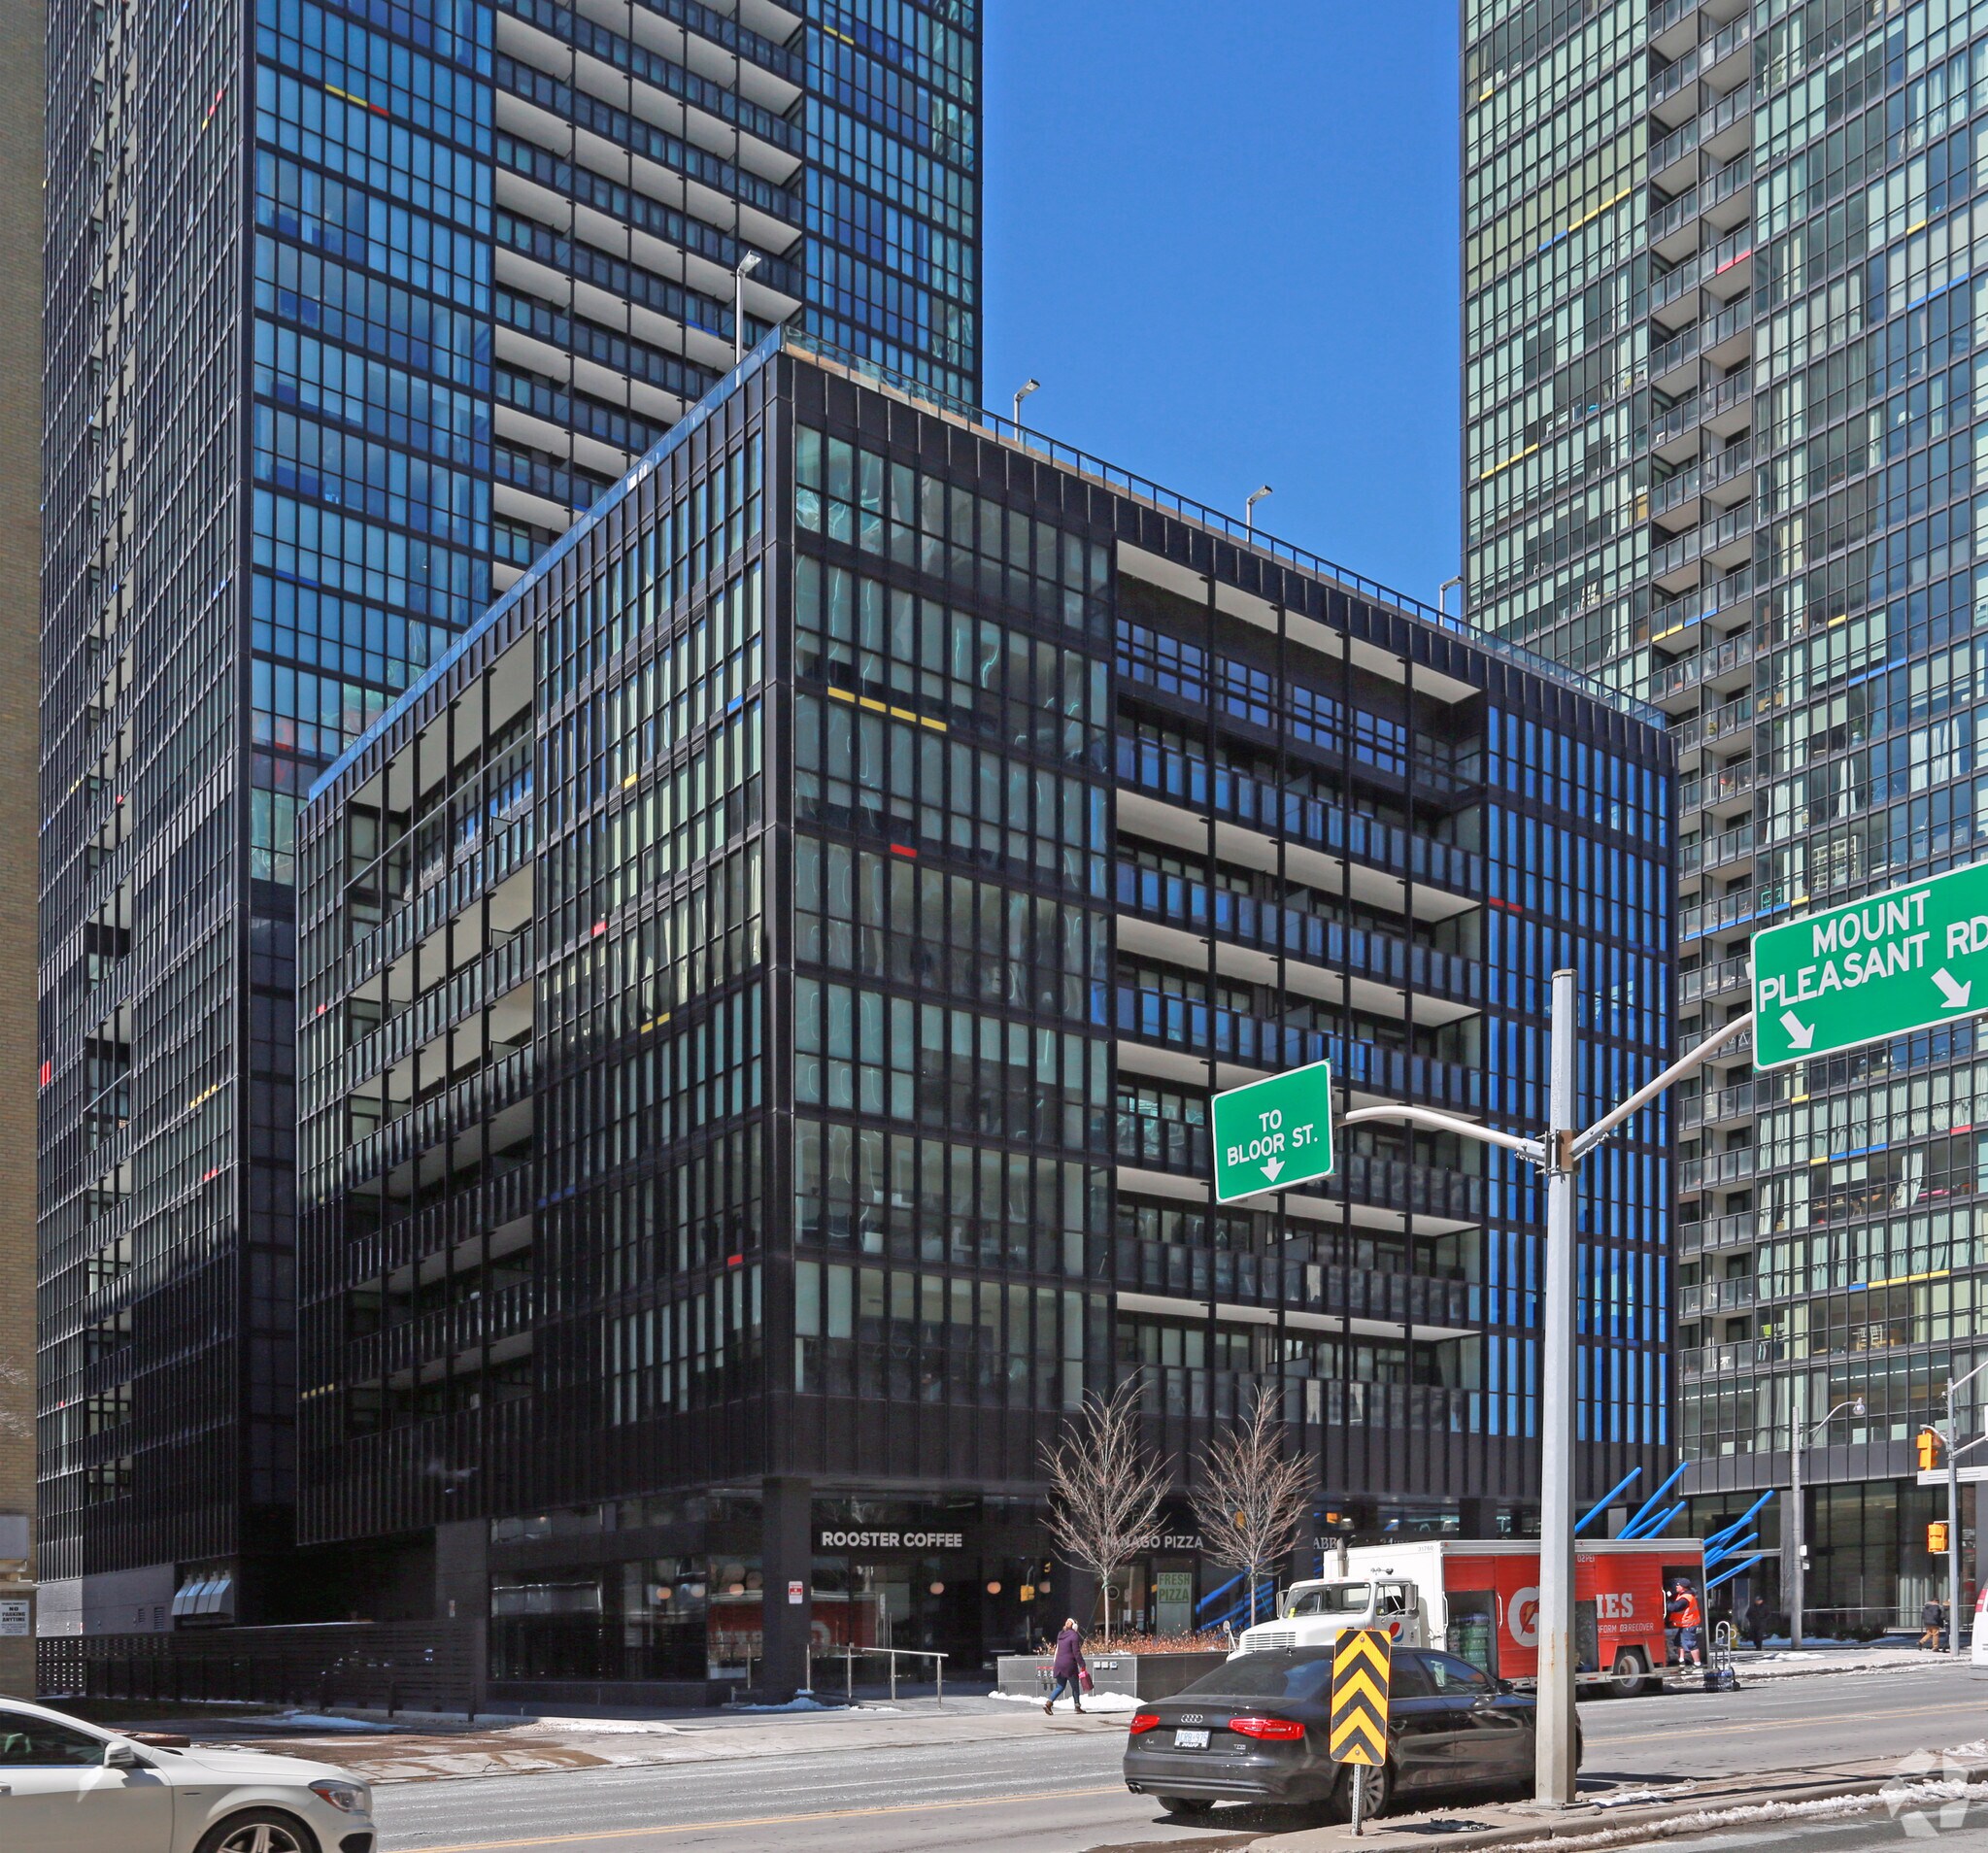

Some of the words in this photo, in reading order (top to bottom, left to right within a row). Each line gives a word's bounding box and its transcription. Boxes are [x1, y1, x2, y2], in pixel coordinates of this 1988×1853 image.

[1812, 890, 1931, 958] MOUNT
[1759, 931, 1930, 1013] PLEASANT
[1259, 1109, 1283, 1132] TO
[1227, 1132, 1285, 1166] BLOOR
[1292, 1124, 1319, 1148] ST.
[822, 1532, 900, 1547] ROOSTER
[903, 1533, 962, 1547] COFFEE
[1164, 1535, 1204, 1549] PIZZA
[1159, 1574, 1190, 1585] FRESH
[1159, 1589, 1189, 1601] PIZZA
